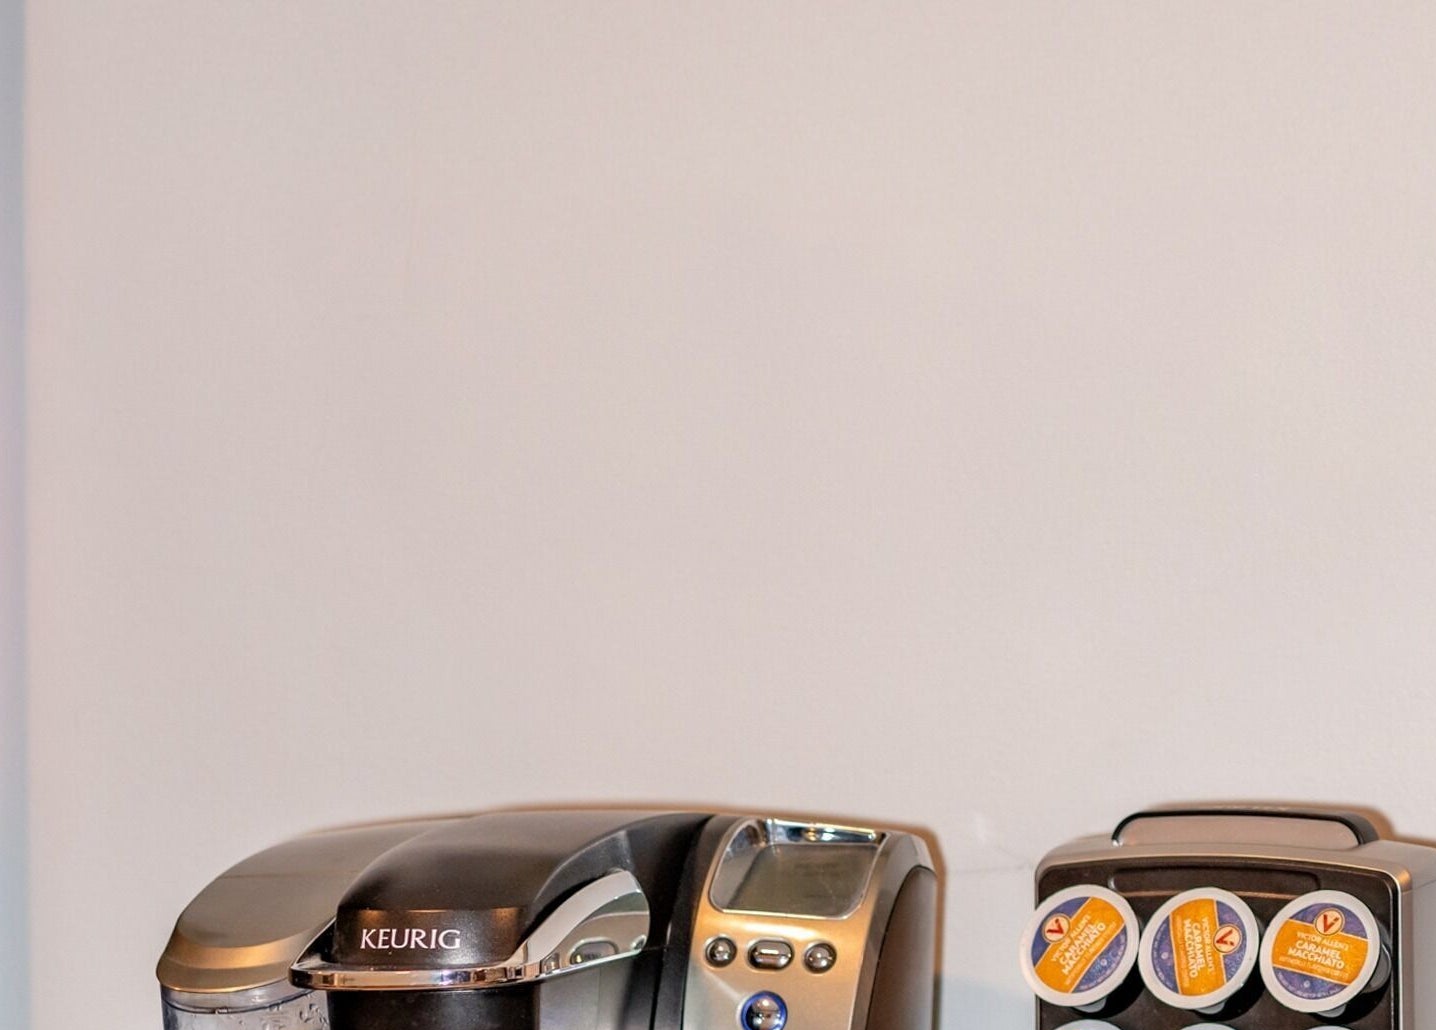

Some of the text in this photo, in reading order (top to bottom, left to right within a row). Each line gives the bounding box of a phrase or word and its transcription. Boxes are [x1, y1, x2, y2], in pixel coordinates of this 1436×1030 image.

[360, 929, 461, 949] KEURIG
[1057, 921, 1096, 965] CARAMEL
[1061, 921, 1106, 975] MACCHIATO
[1183, 918, 1197, 978] MACCHIATO
[1192, 922, 1205, 970] CARAMEL
[1287, 947, 1345, 969] MACCHIATO
[1295, 940, 1343, 959] CARAMEL
